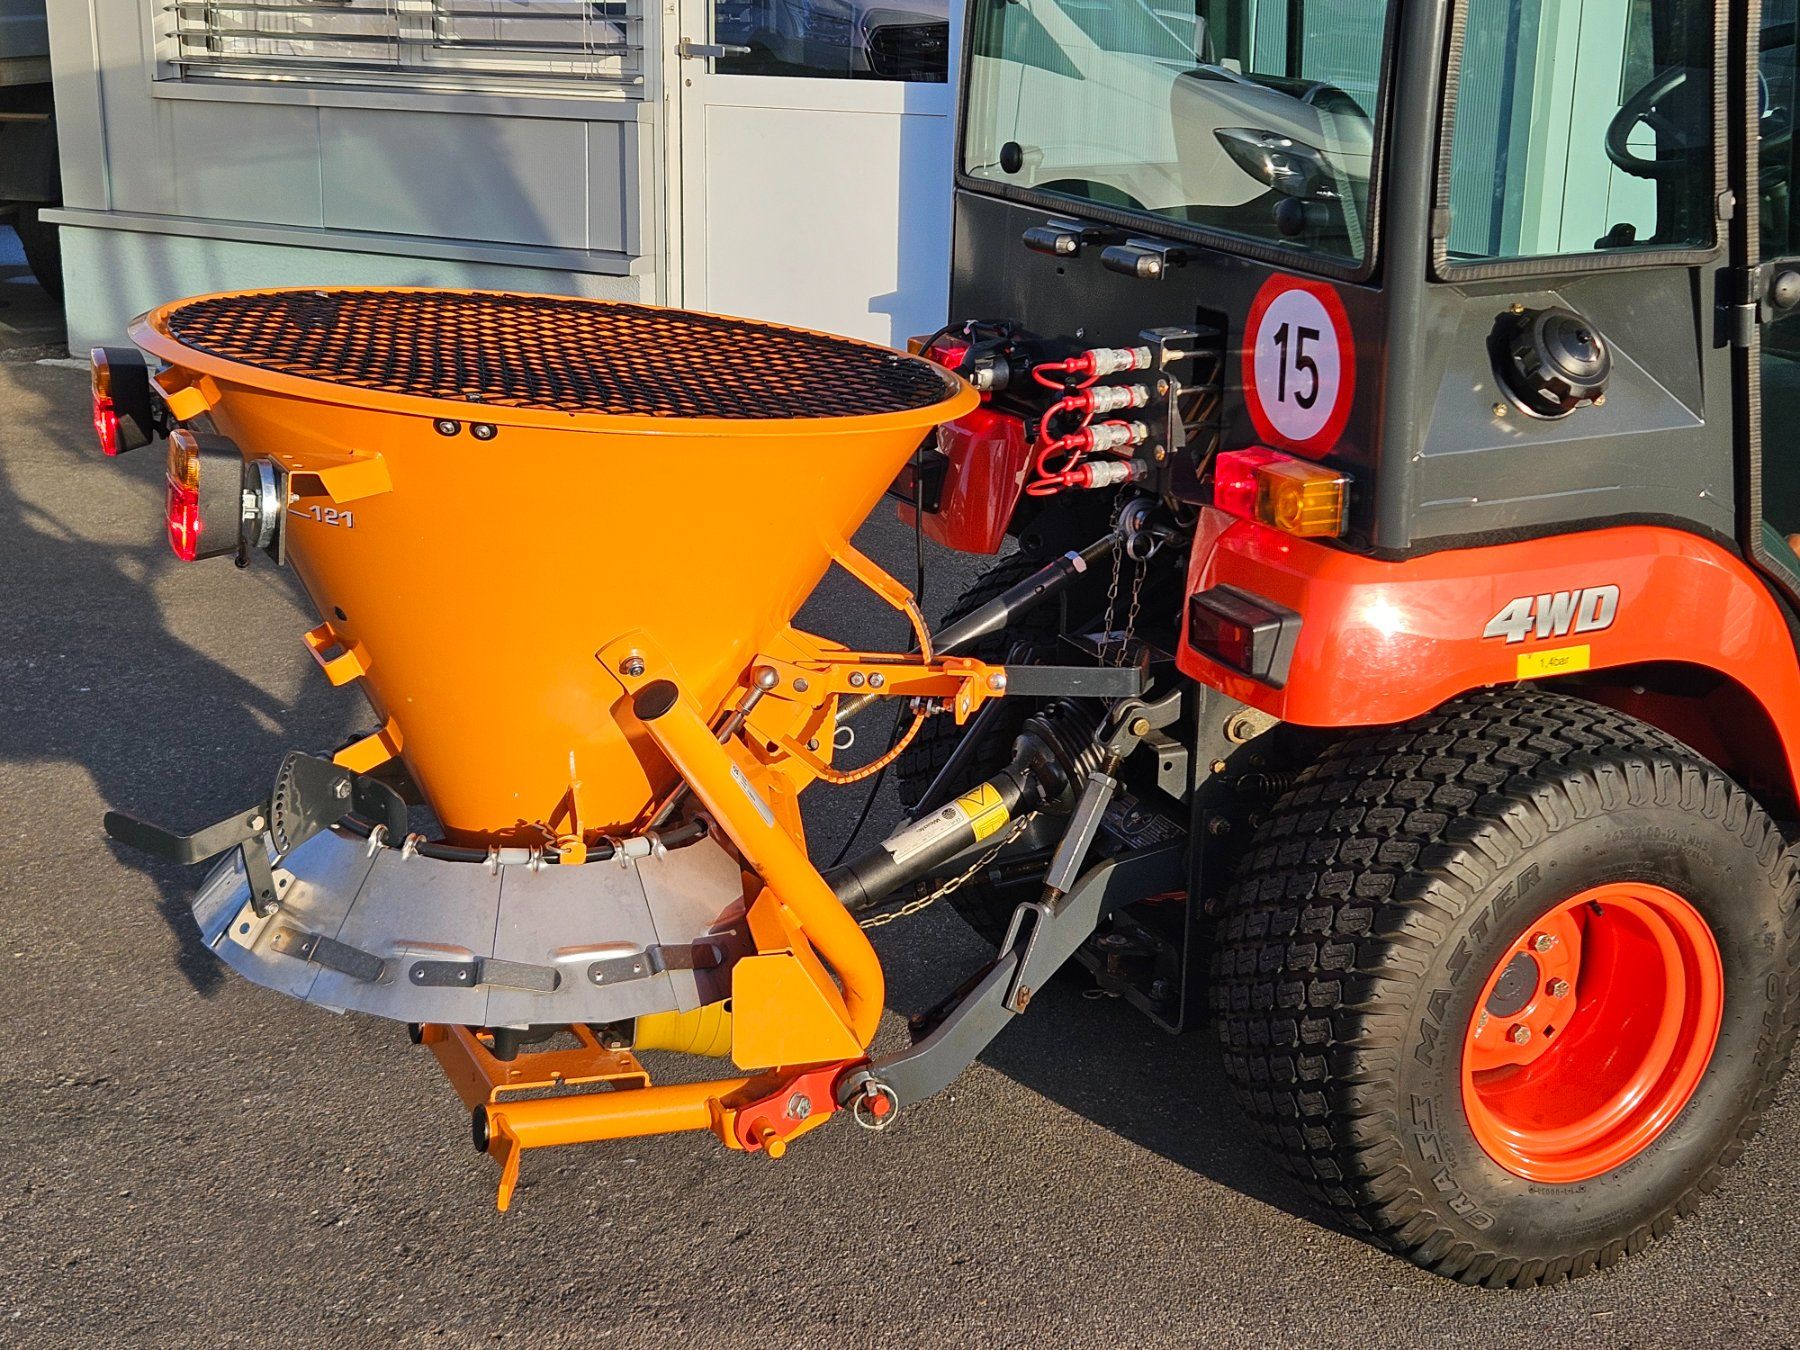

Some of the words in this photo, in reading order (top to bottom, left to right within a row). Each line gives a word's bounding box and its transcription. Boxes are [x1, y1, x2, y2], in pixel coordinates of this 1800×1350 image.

[1273, 322, 1320, 410] 15
[309, 505, 354, 529] 121
[1482, 584, 1620, 644] 4WD
[1415, 862, 1541, 1068] MASTER
[1410, 1093, 1496, 1231] GRASS
